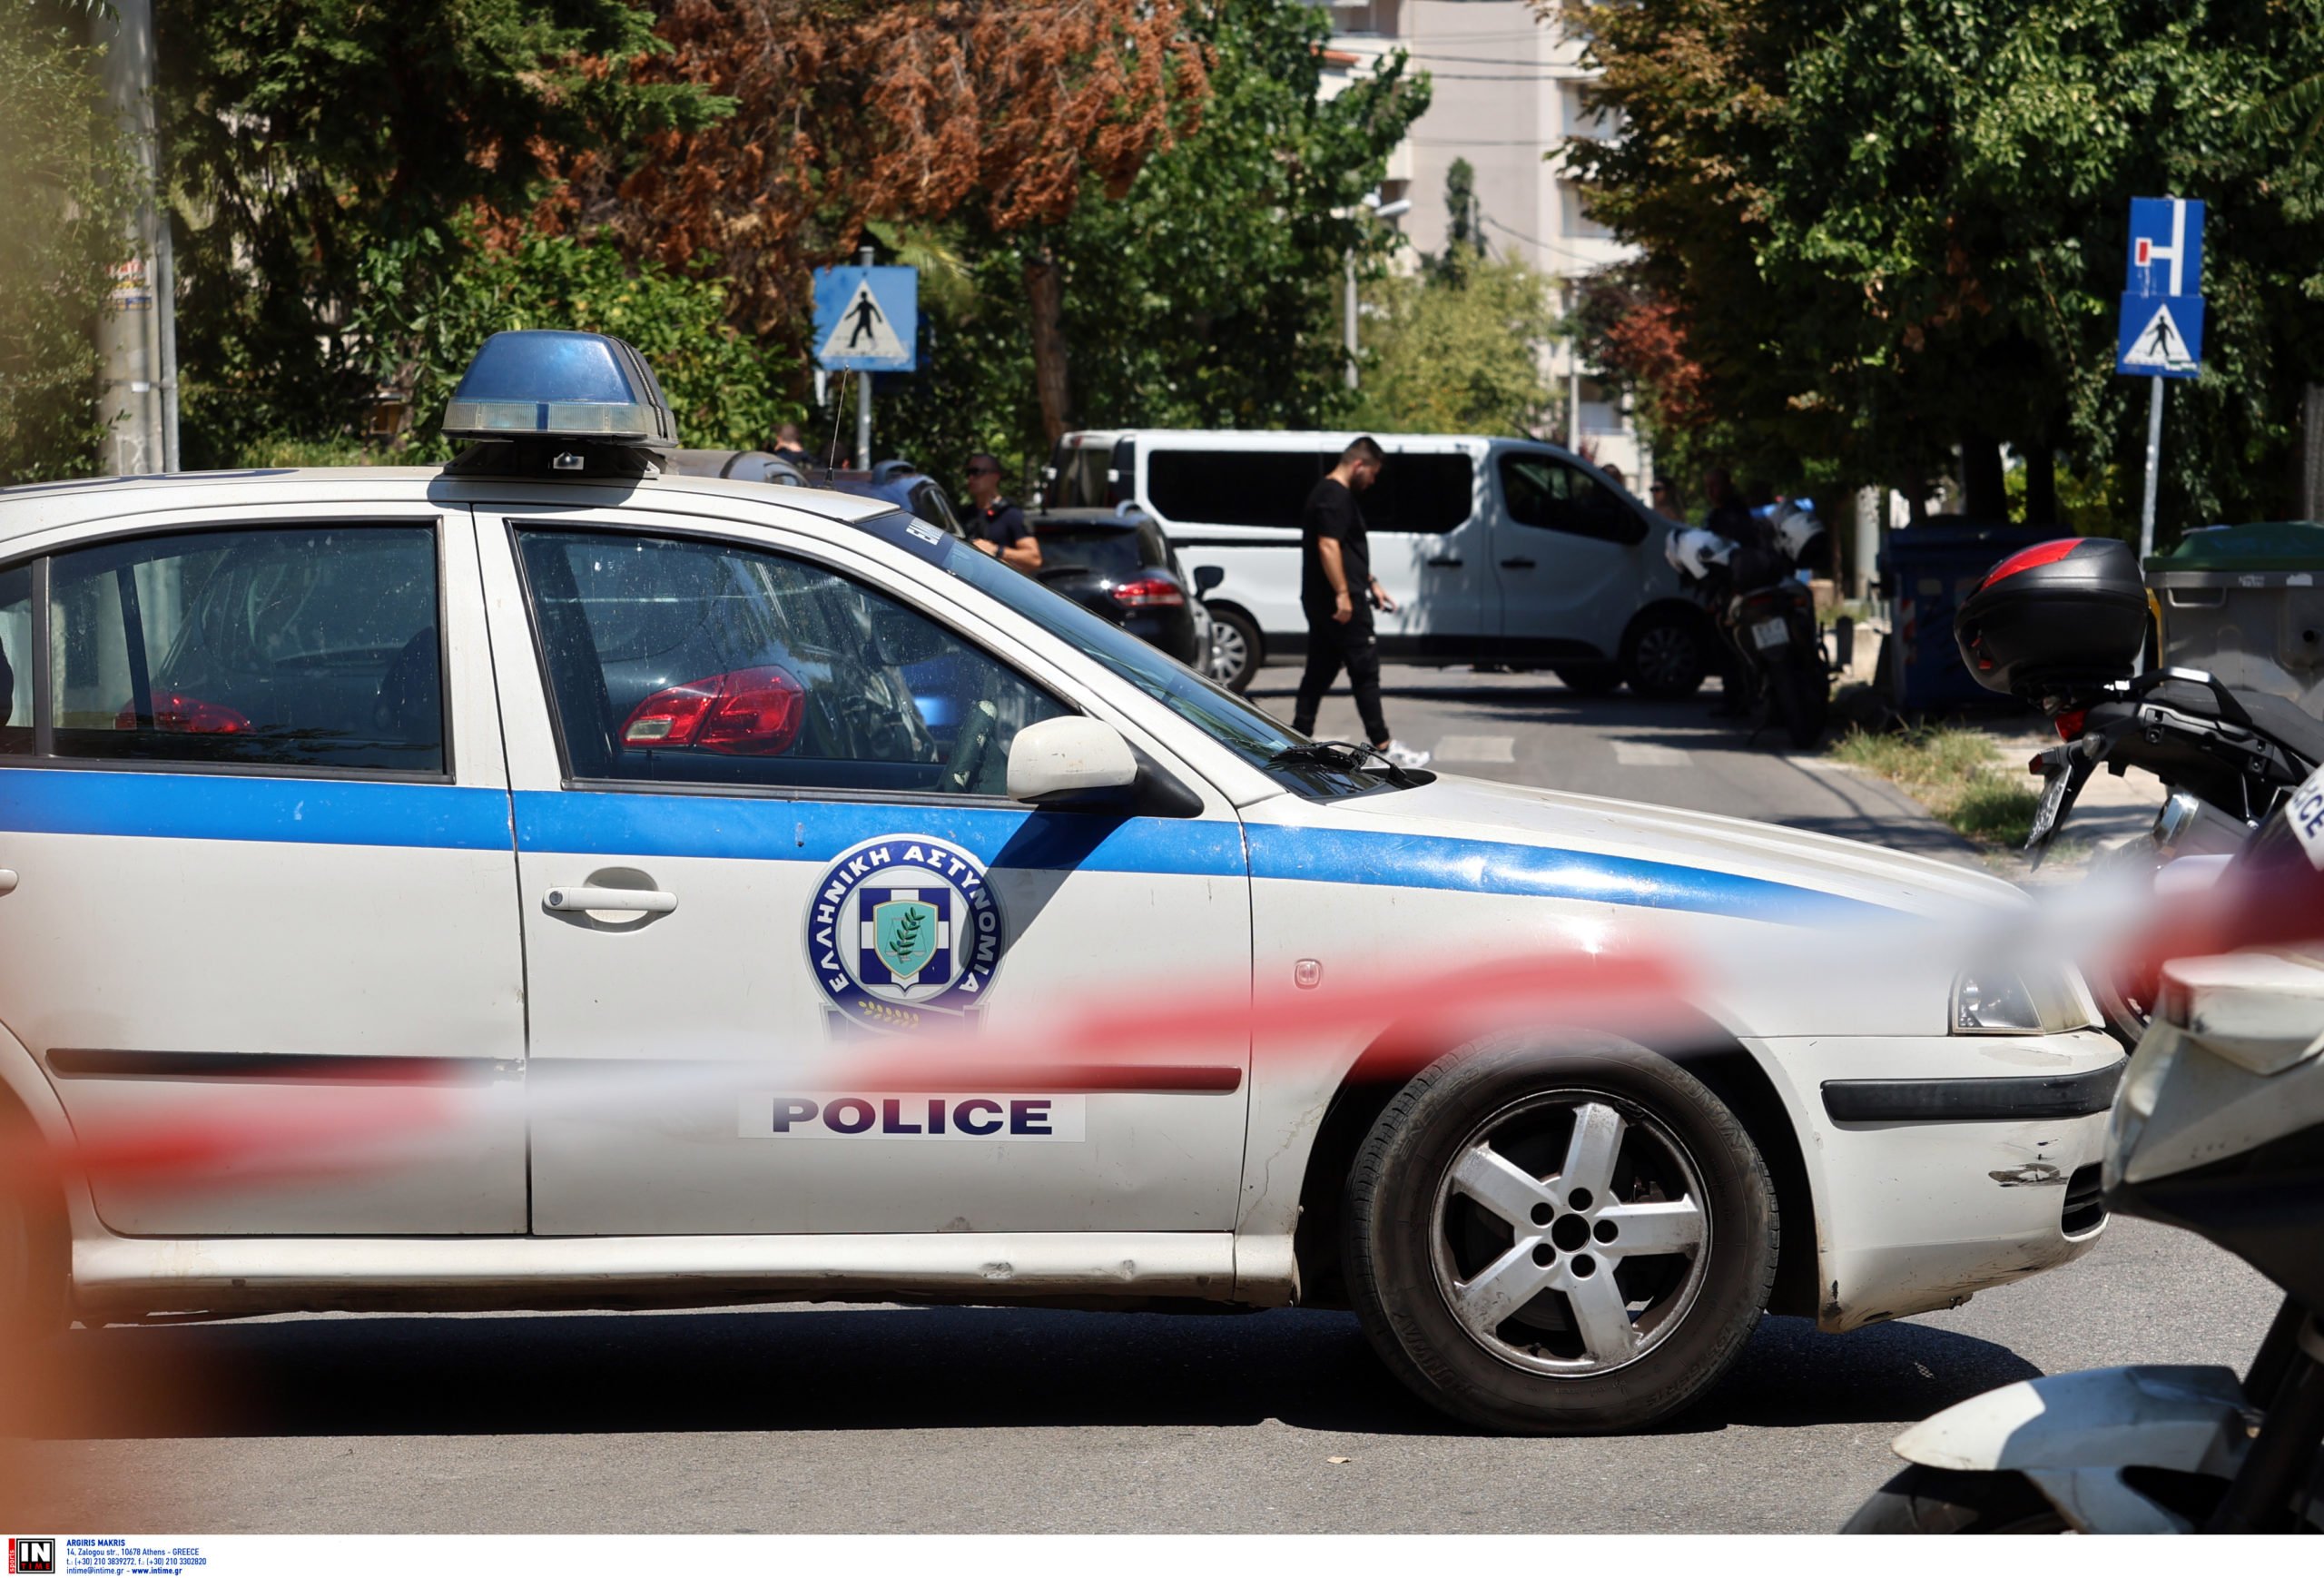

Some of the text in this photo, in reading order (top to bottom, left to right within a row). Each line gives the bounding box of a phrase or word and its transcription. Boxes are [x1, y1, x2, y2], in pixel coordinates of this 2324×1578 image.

[816, 844, 997, 993] ΕΛΛΗΝΙΚΗ ΑΣΤΥΝΟΜΙΑ
[772, 1097, 1053, 1136] POLICE
